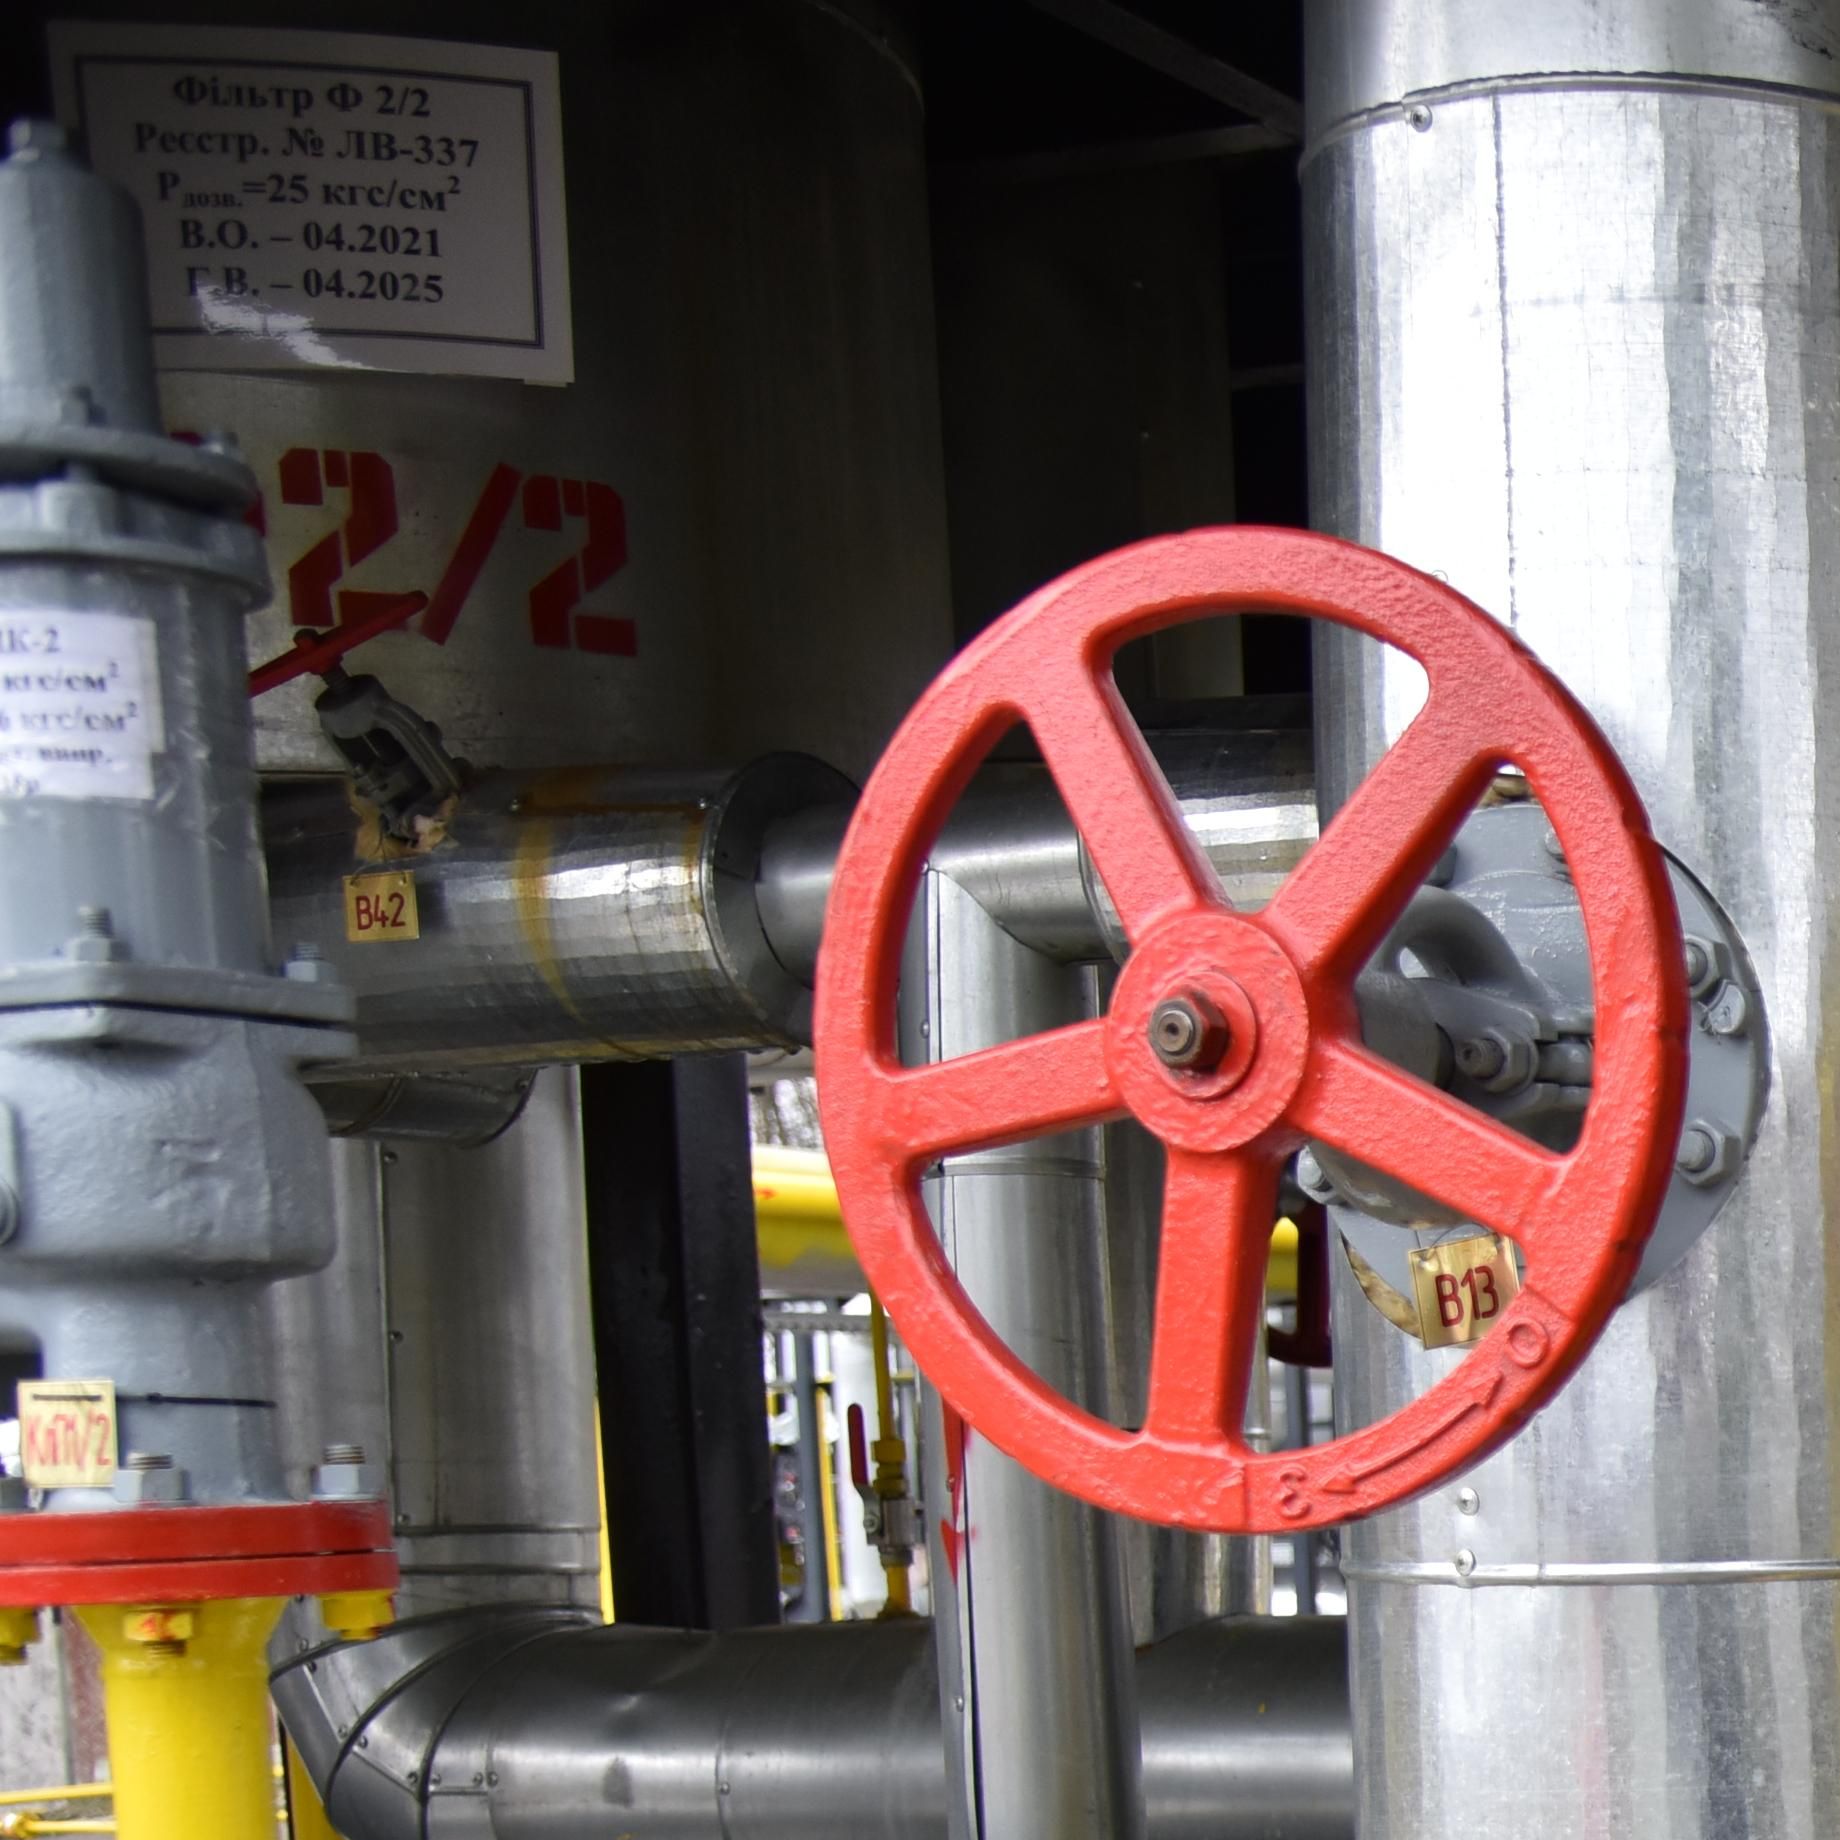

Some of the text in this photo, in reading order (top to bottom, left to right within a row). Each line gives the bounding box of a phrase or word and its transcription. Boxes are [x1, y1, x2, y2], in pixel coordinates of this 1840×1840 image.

[172, 76, 431, 120] Фільтр Ф 2/2
[335, 130, 480, 168] ЛВ-337
[179, 218, 260, 250] В.О.
[302, 221, 442, 258] 04.2021
[302, 268, 443, 303] 04.2025
[355, 891, 407, 931] В42
[1434, 1265, 1500, 1328] В13
